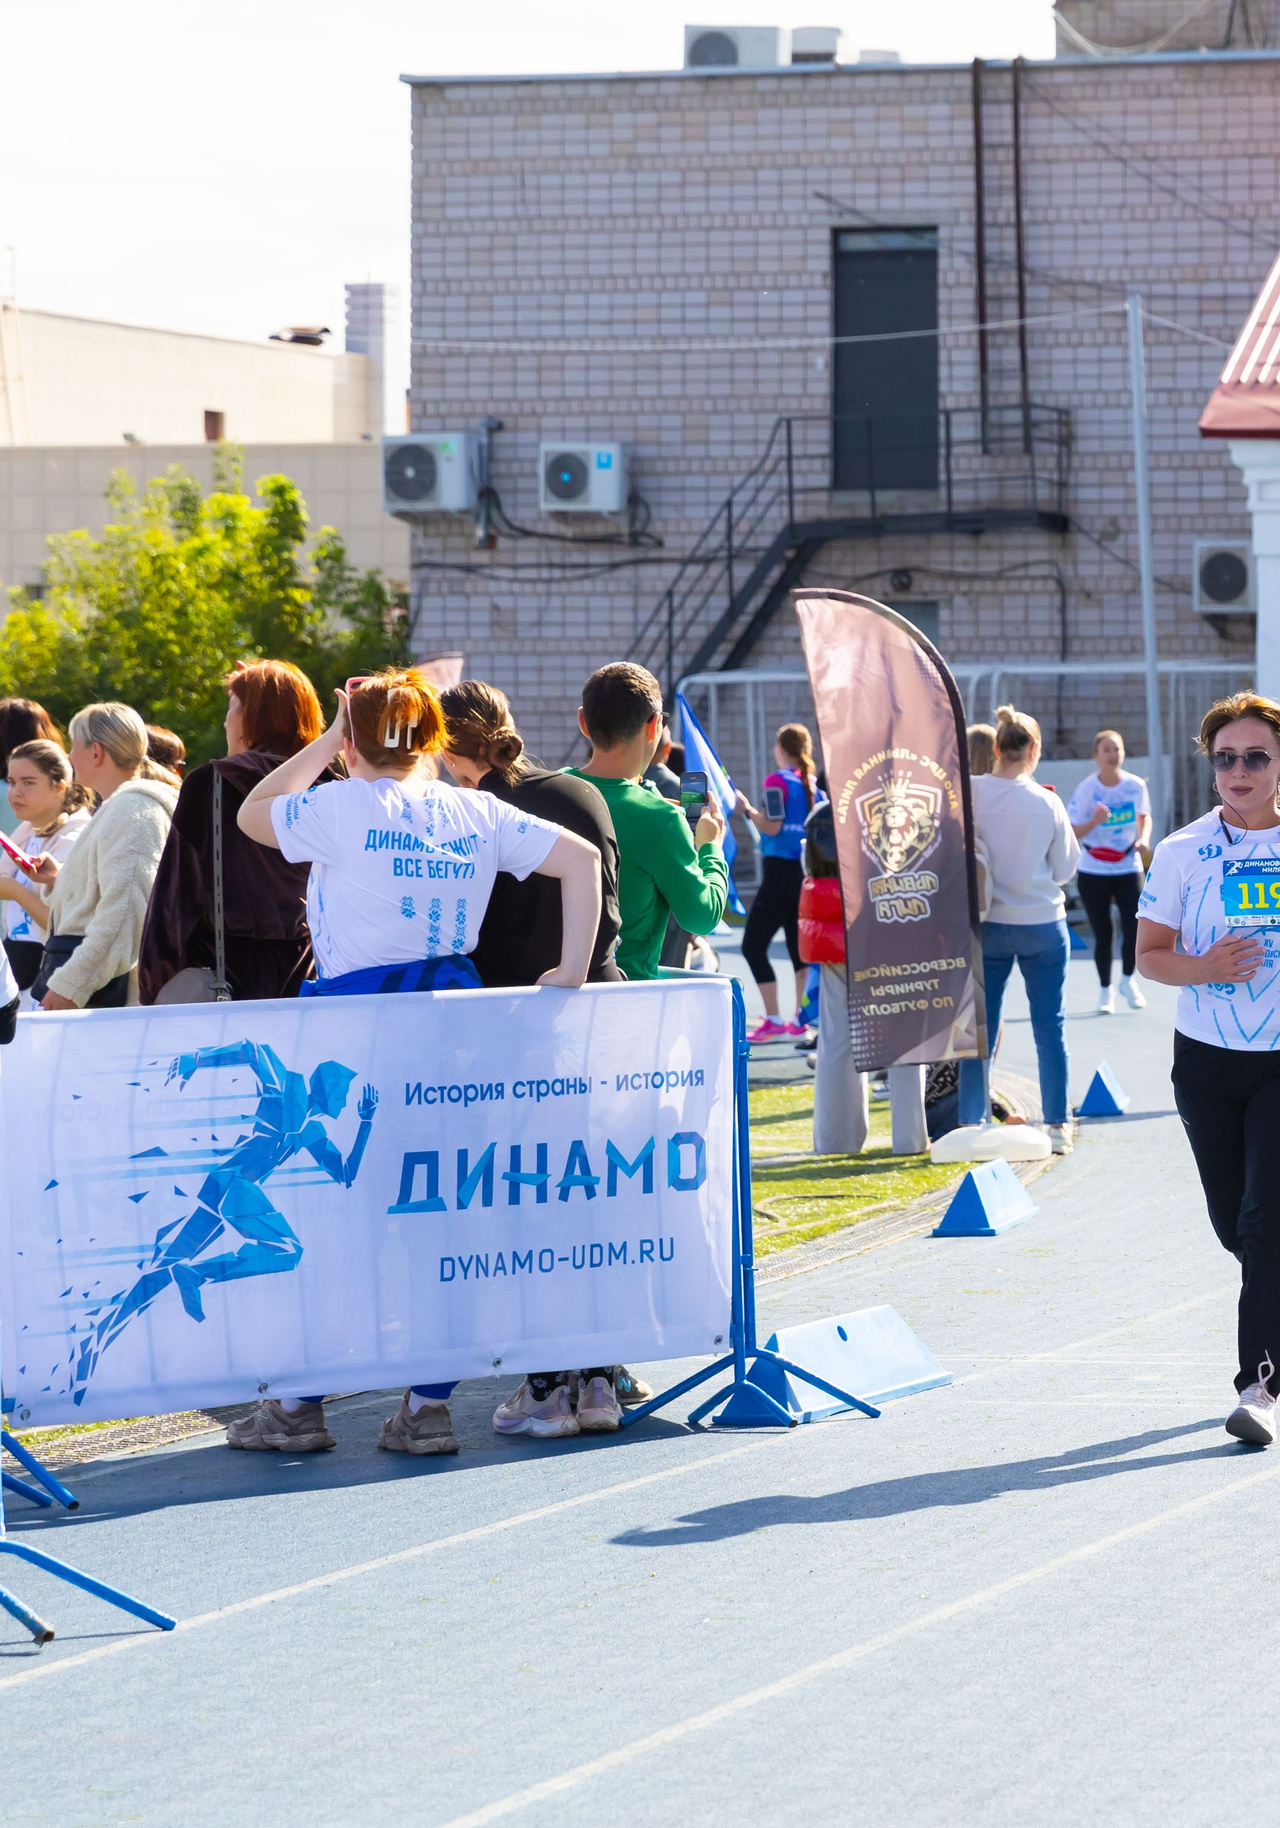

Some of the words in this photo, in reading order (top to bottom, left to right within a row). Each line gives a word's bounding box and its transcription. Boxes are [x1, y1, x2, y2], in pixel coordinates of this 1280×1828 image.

[436, 834, 479, 858] ЕЖИТ
[393, 857, 423, 878] ВСЕ
[427, 860, 476, 879] БЕГУТ!
[405, 1081, 505, 1108] История
[512, 1076, 593, 1103] страны
[615, 1069, 705, 1093] история
[387, 1131, 707, 1214] ДИНАМО
[440, 1237, 675, 1283] DYNAMO-UDM.RU
